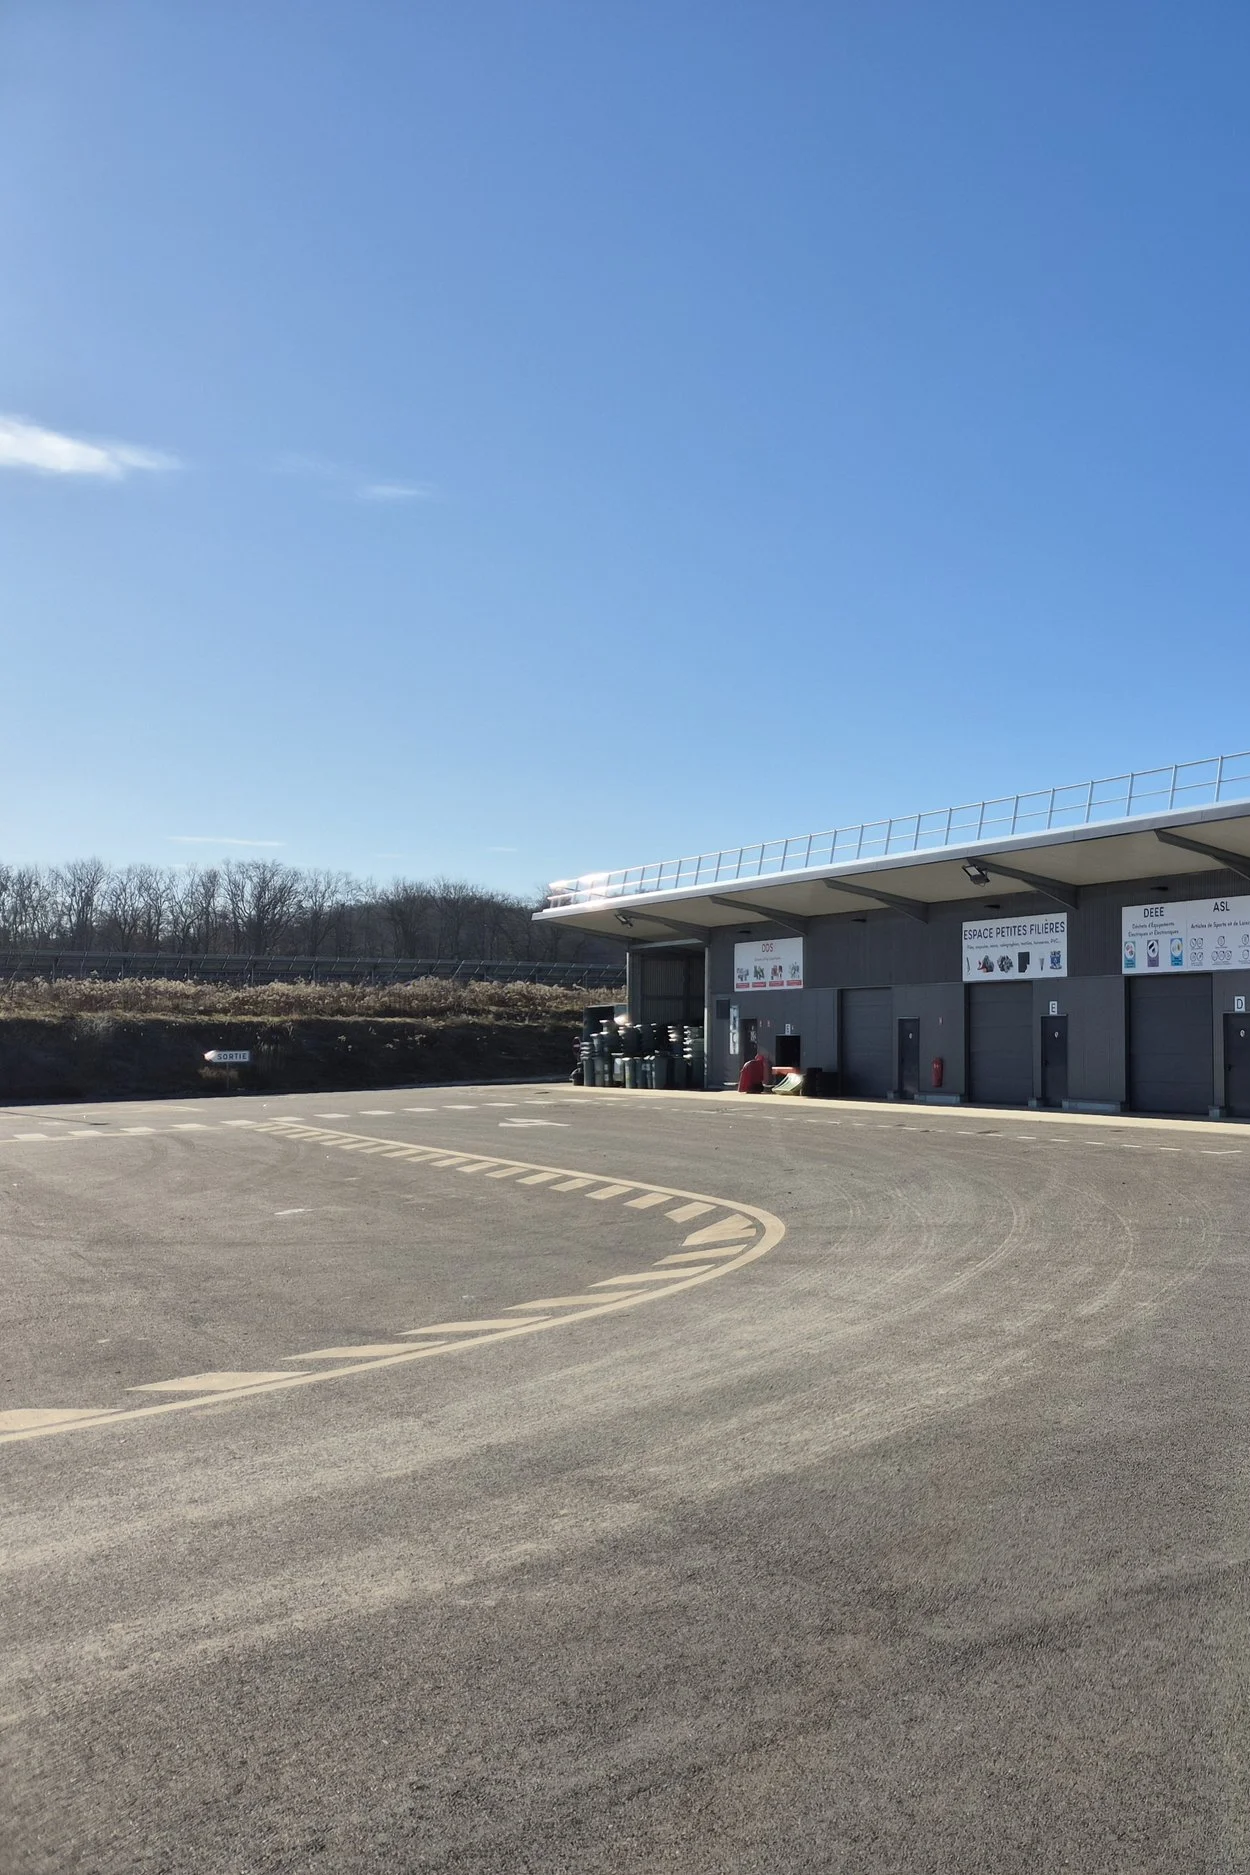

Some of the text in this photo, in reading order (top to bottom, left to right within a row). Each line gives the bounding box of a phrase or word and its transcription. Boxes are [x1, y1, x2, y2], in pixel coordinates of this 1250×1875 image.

[1213, 901, 1230, 912] ASL
[1143, 907, 1164, 918] DEEE
[963, 919, 1065, 940] ESPACE PETITES FILIÈRES
[1236, 998, 1243, 1009] D
